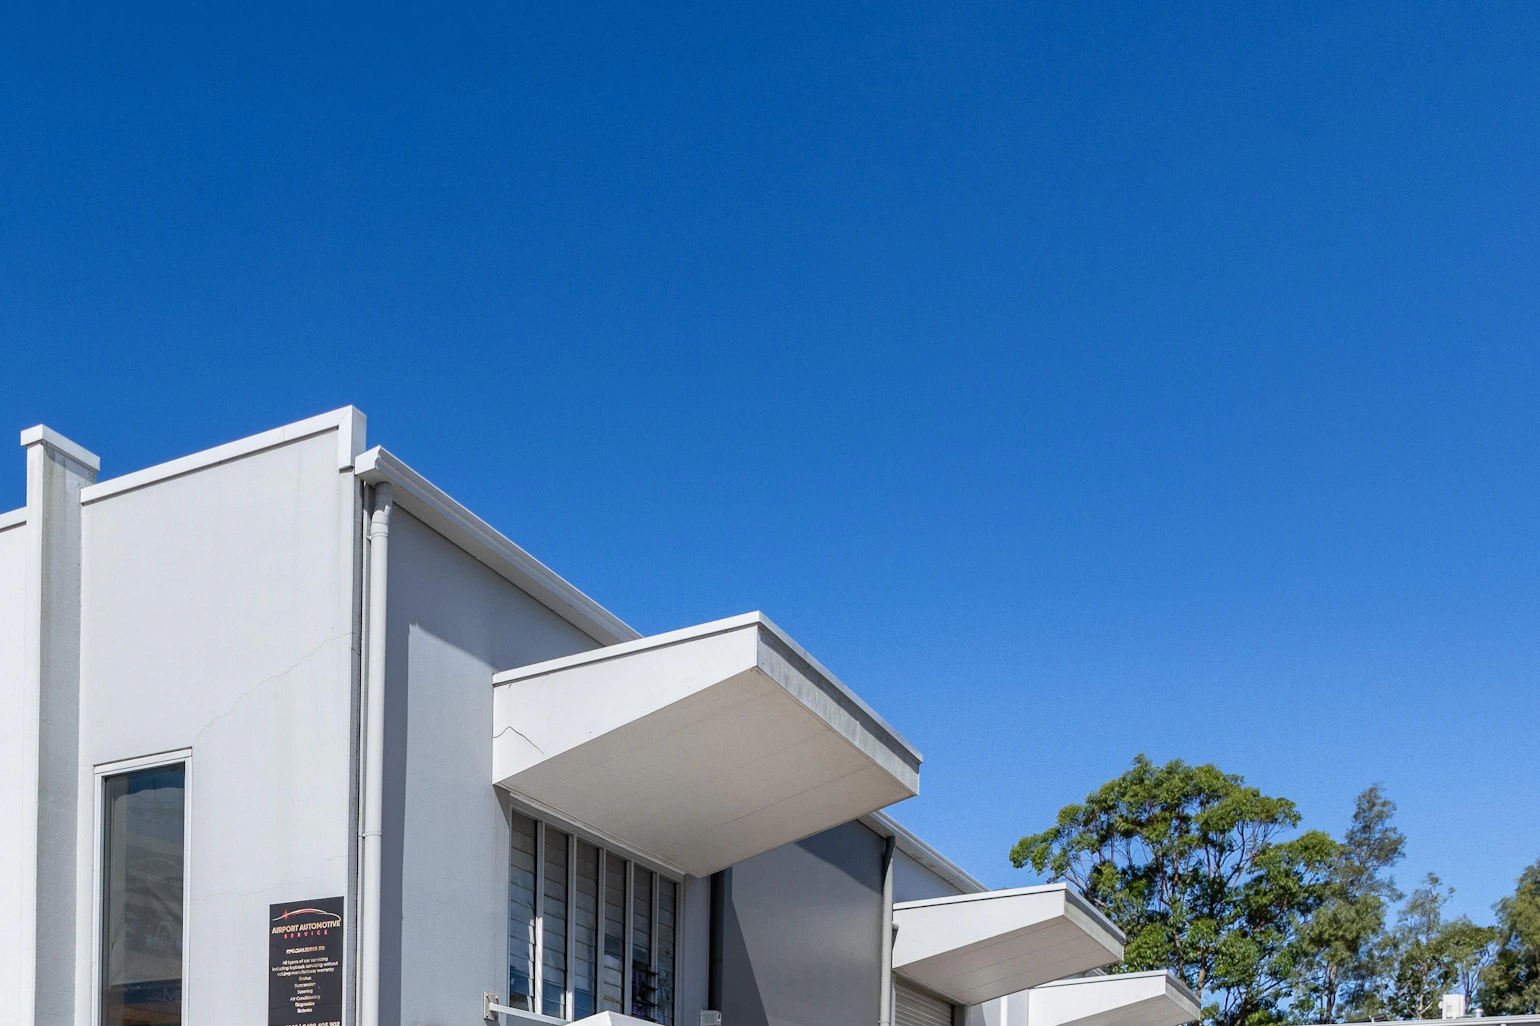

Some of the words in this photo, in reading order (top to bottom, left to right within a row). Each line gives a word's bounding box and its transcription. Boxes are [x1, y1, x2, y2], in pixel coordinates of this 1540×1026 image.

[271, 925, 298, 935] AIRPORT
[299, 920, 340, 932] AUTOMOTIVE
[283, 929, 328, 939] SERVICE
